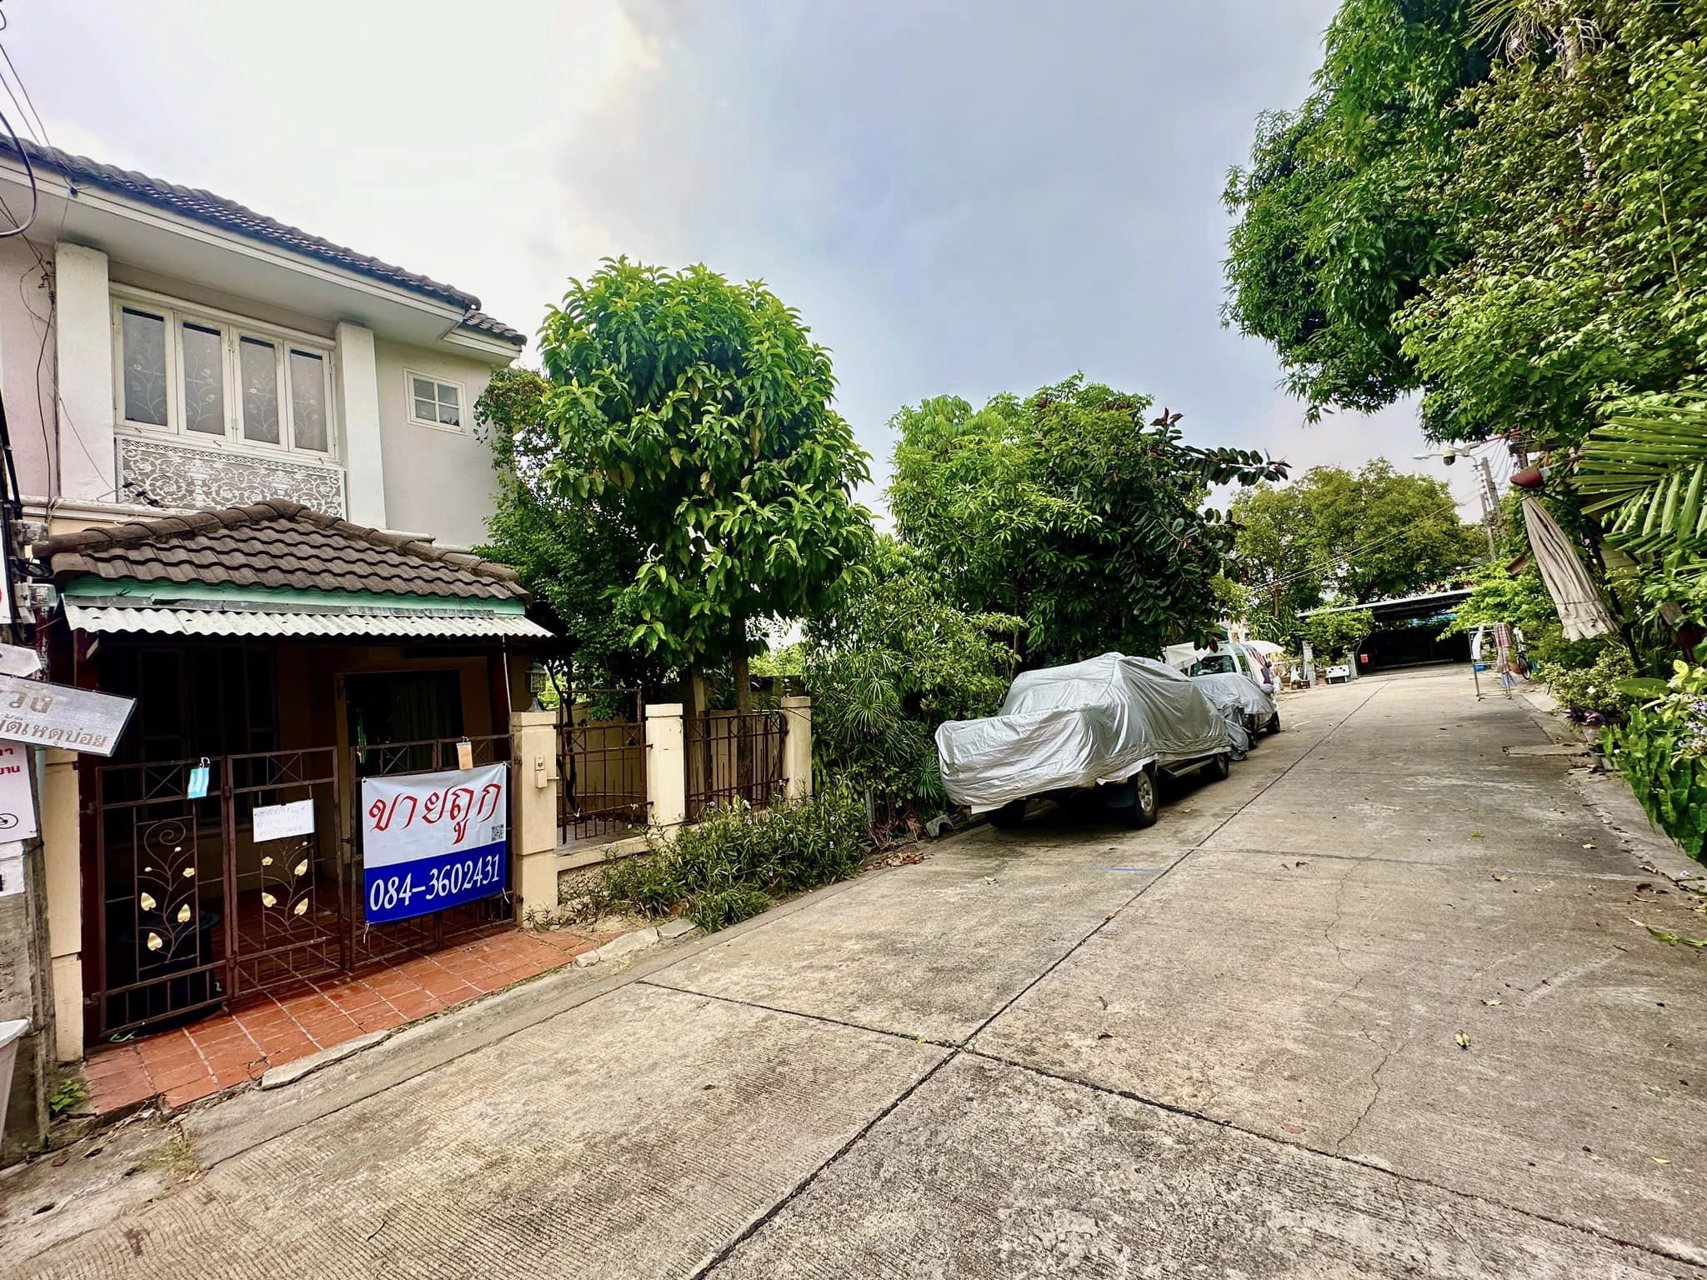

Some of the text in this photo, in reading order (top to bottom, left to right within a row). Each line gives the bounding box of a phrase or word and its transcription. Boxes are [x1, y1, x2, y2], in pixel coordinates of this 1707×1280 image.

[0, 682, 54, 714] วัง
[368, 783, 502, 845] ขายถูก
[369, 854, 500, 911] 084-3602431
